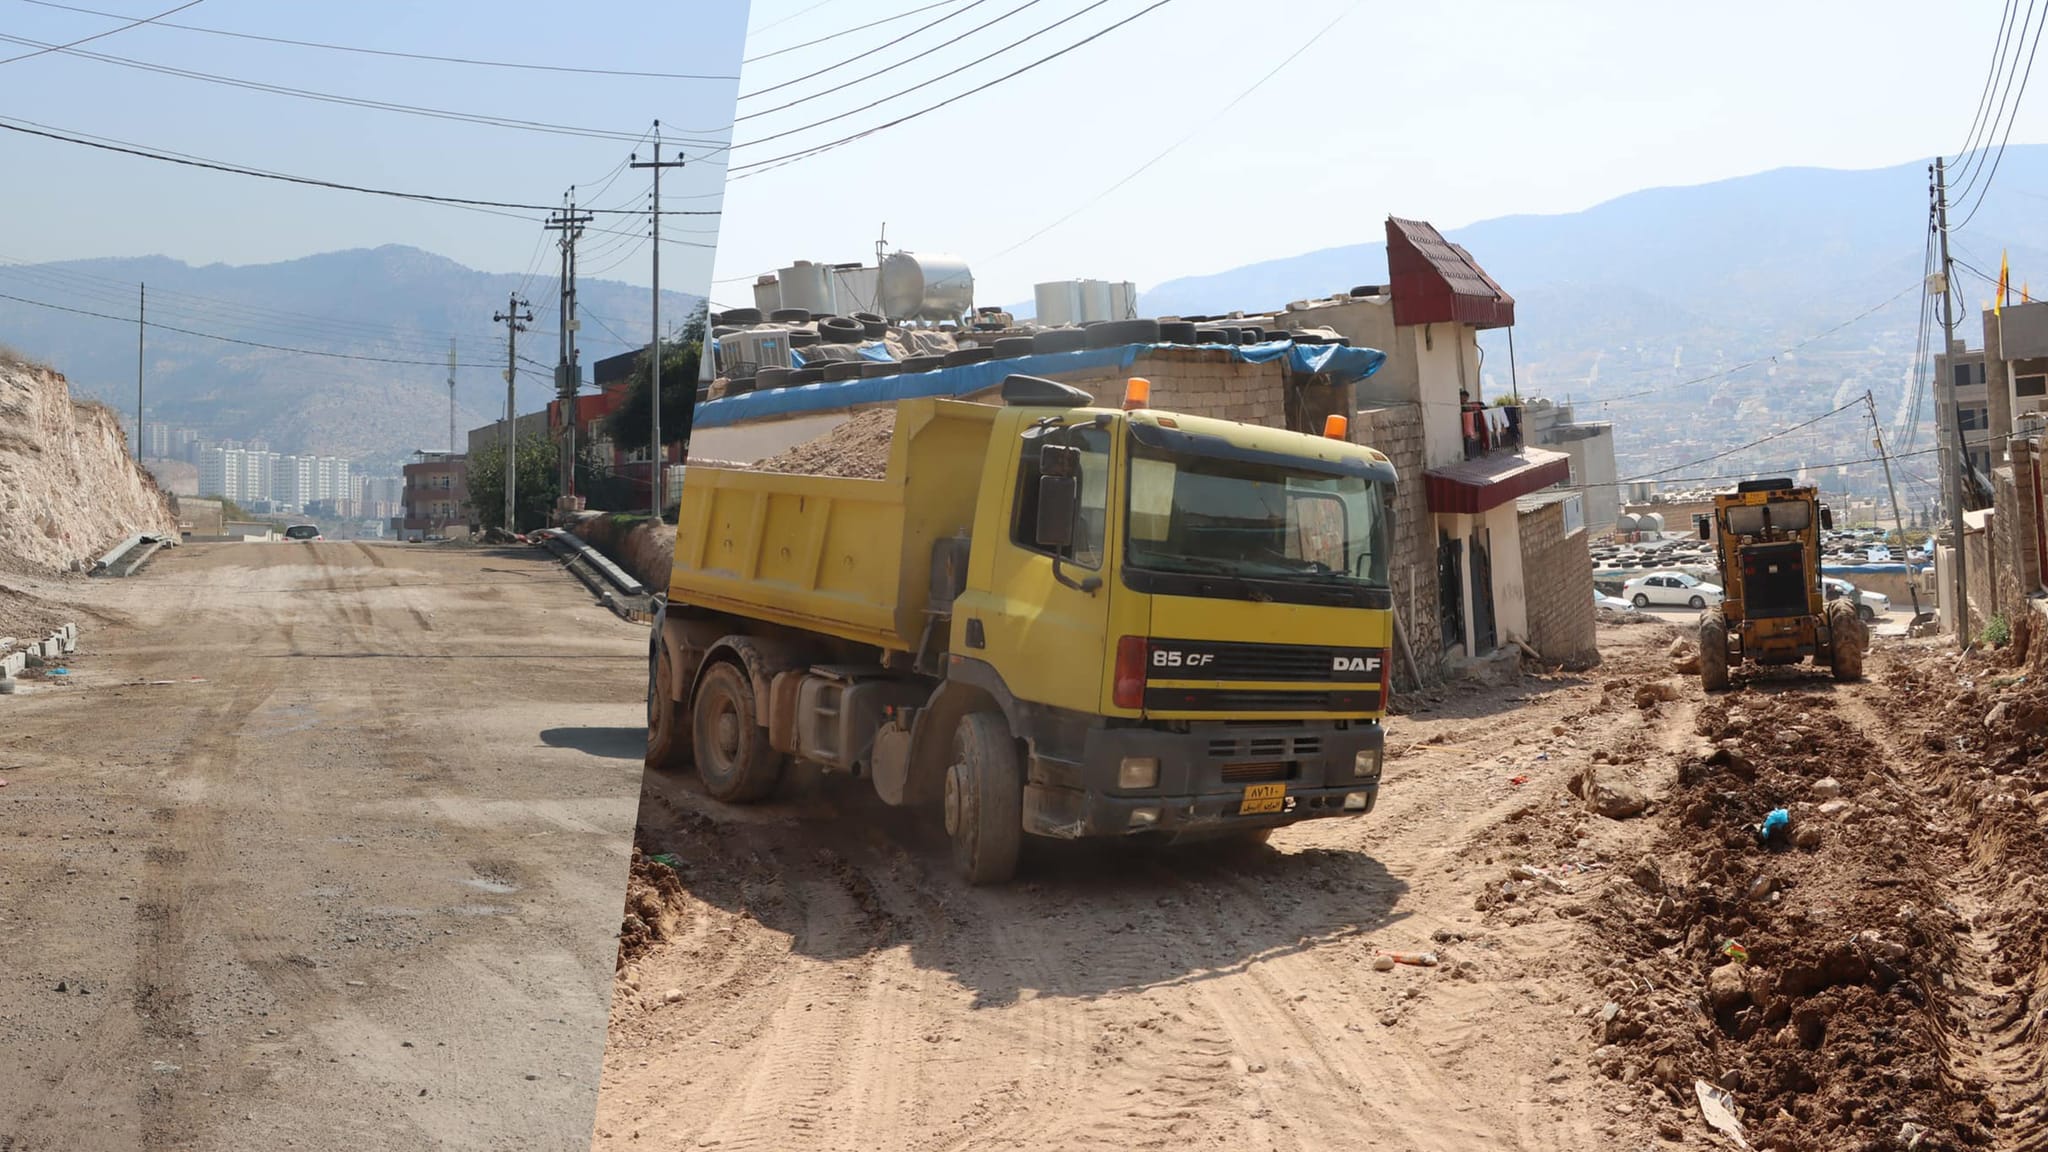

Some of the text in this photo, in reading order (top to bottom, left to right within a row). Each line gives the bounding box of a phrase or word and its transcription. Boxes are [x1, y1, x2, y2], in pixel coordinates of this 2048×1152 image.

[1153, 650, 1215, 667] 85 CF
[1333, 656, 1381, 672] DAF
